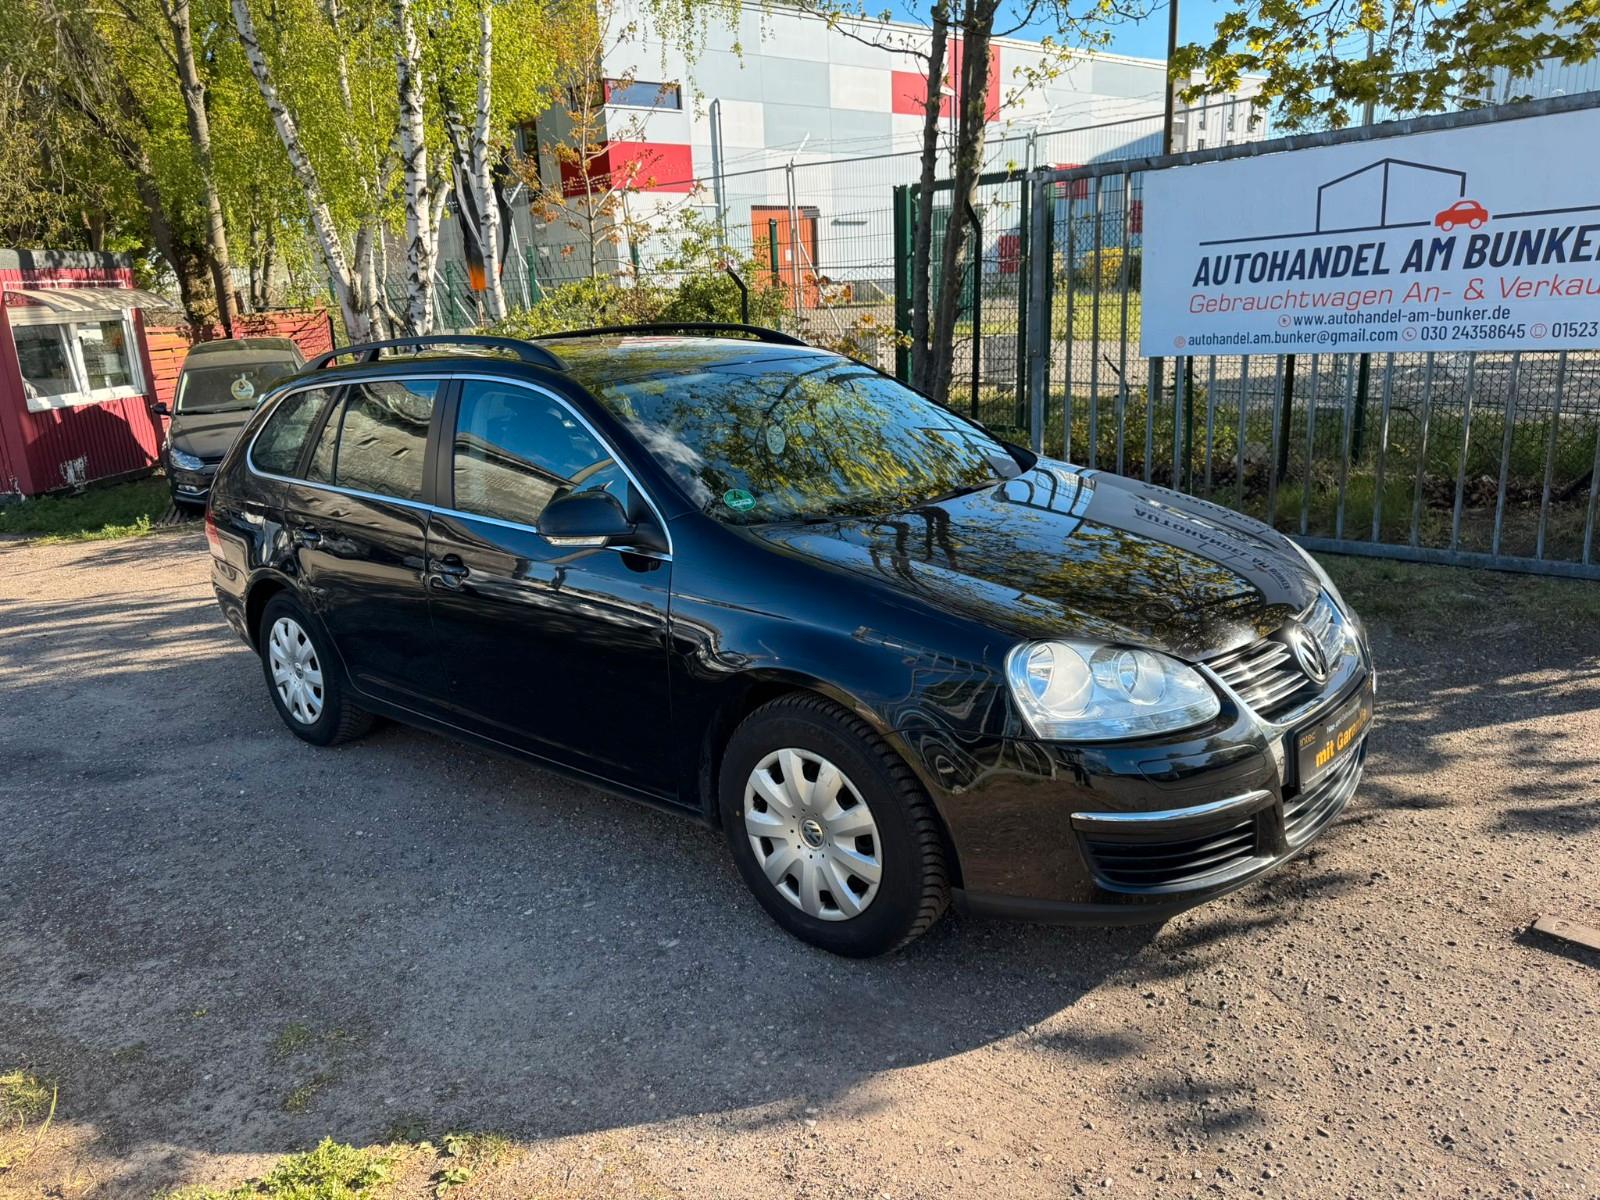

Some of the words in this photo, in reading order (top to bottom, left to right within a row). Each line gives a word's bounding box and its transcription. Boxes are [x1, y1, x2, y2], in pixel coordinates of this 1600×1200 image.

[1192, 241, 1390, 287] AUTOHANDEL
[1400, 236, 1456, 273] AM
[1189, 288, 1393, 311] Gebrauchtwagen
[1402, 282, 1452, 304] An-
[1463, 277, 1485, 301] &
[1293, 305, 1511, 326] www.autohandel-am-bunker.de
[1188, 328, 1398, 346] autohandel.am.bunker@gmail.com
[1421, 326, 1448, 341] 030
[1452, 323, 1526, 340] 24358645
[1551, 321, 1599, 338] 01523
[1316, 740, 1335, 768] mit
